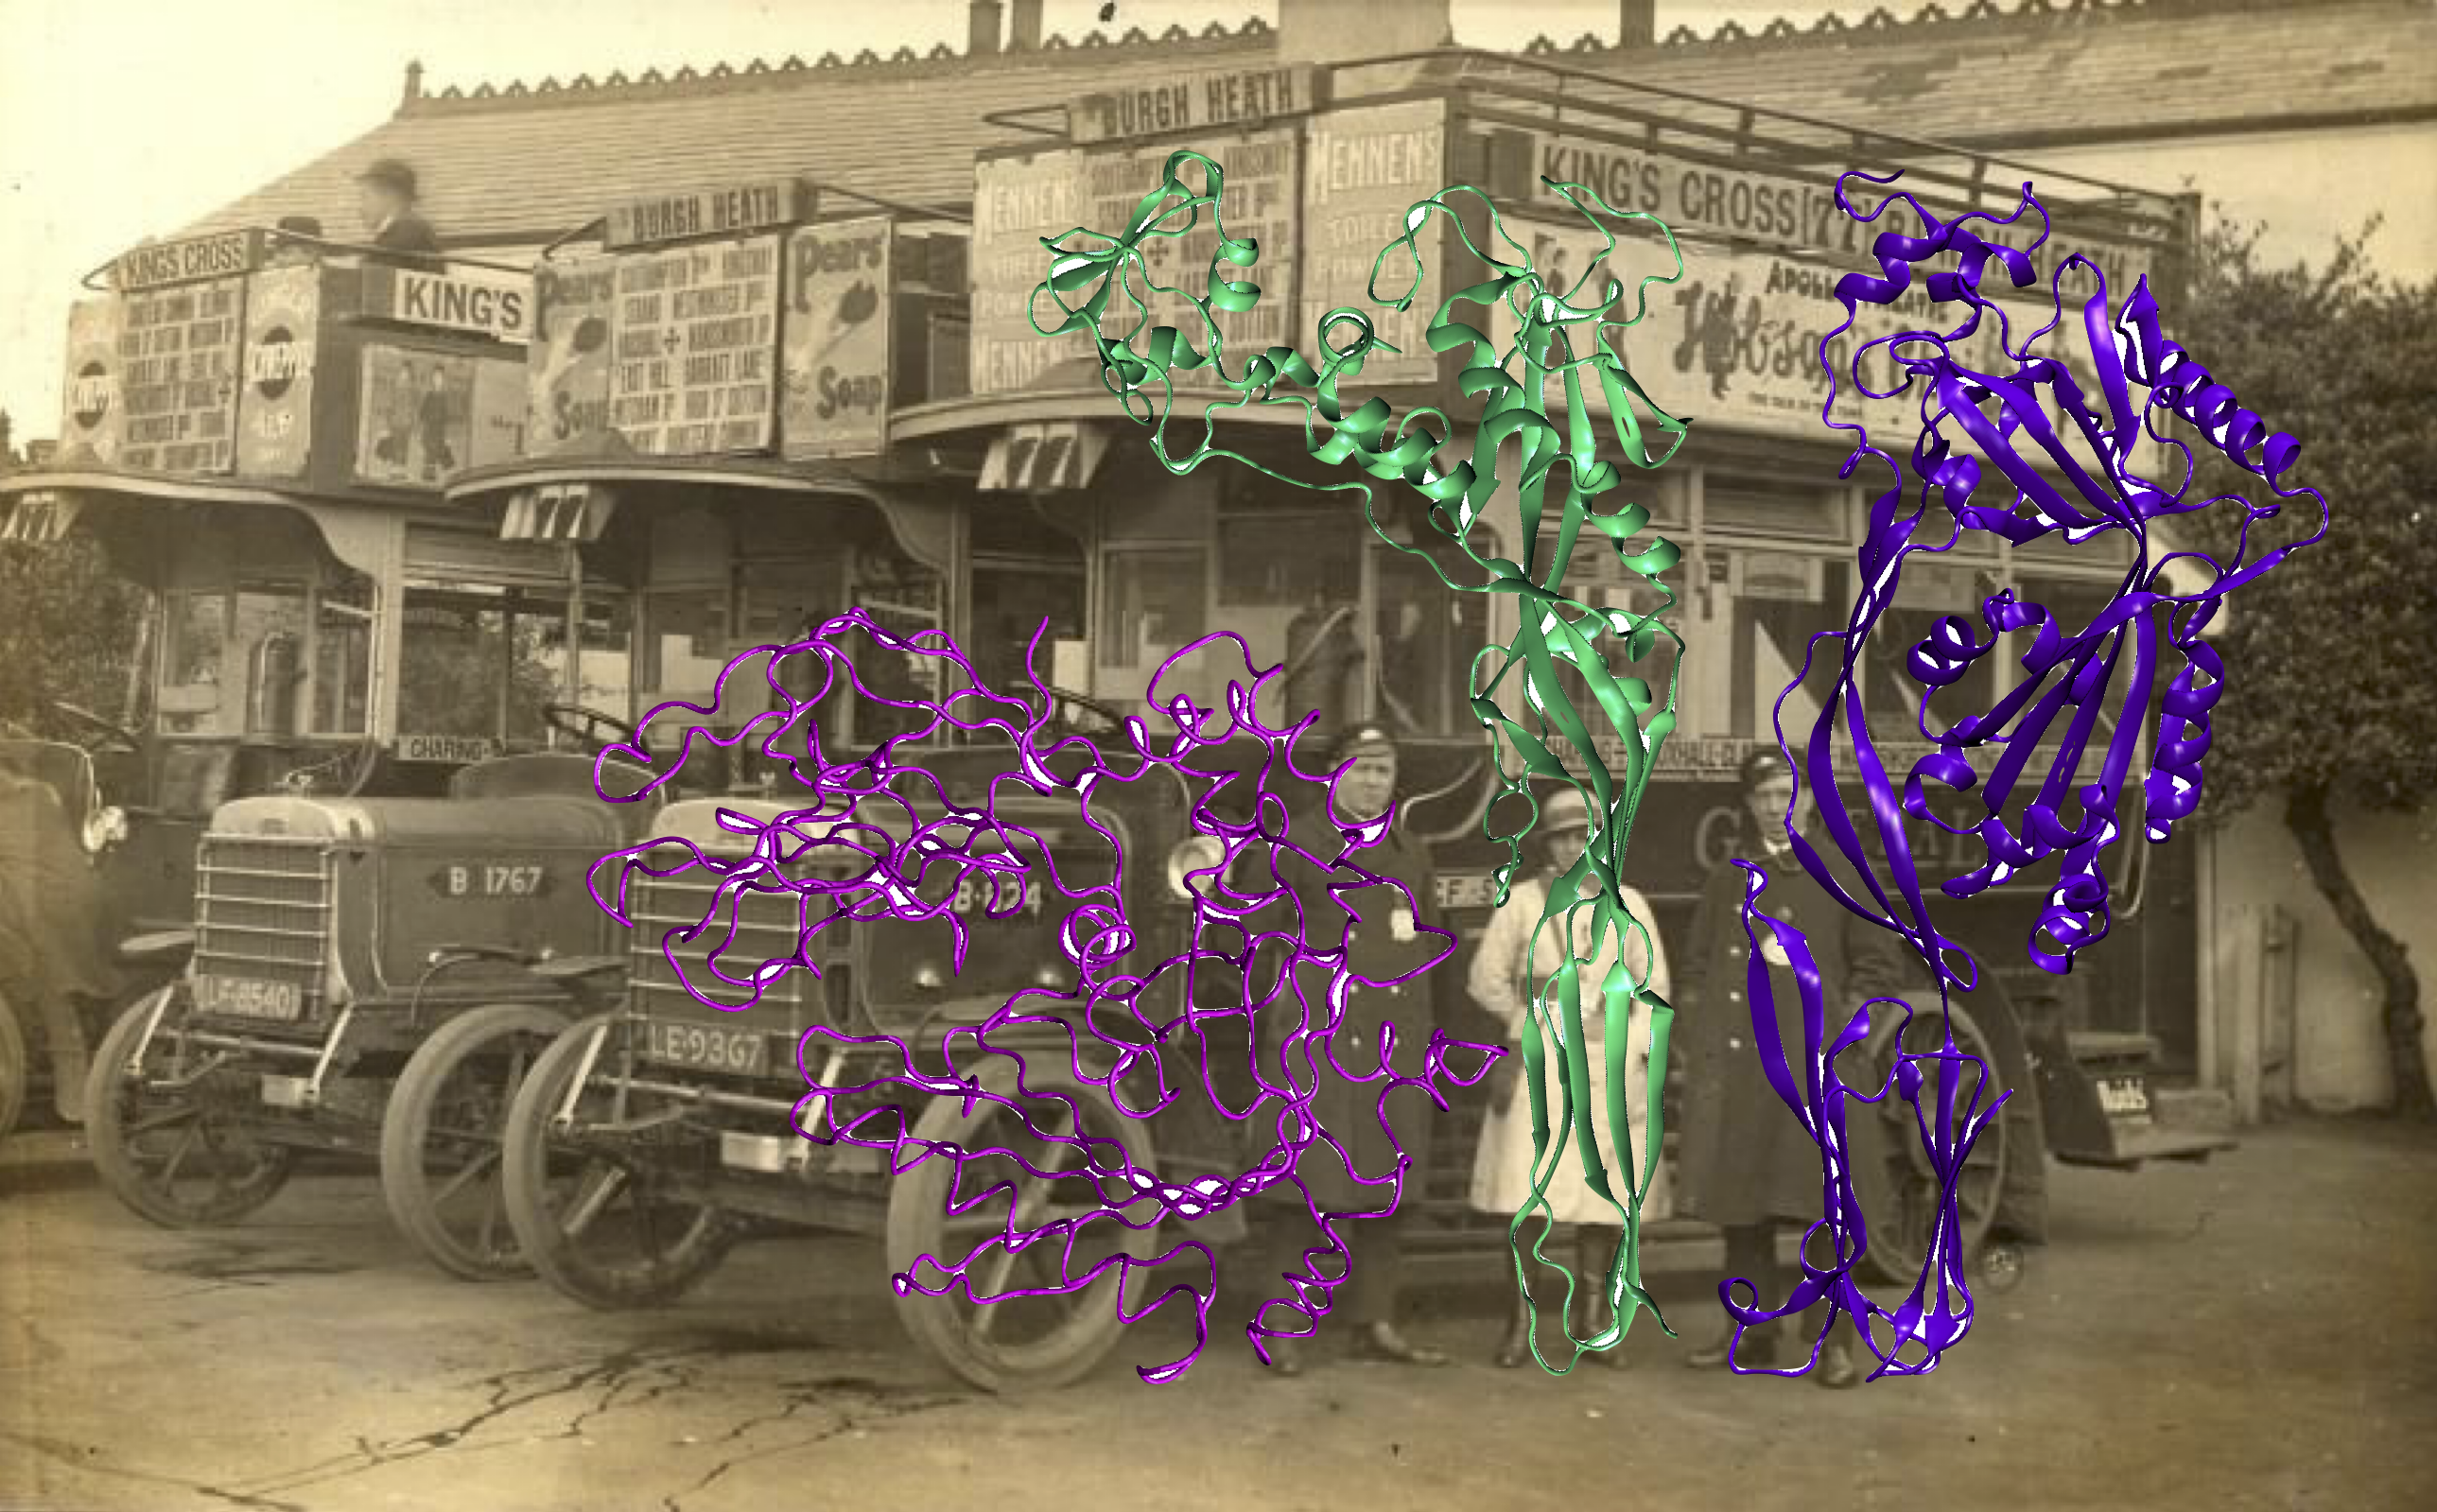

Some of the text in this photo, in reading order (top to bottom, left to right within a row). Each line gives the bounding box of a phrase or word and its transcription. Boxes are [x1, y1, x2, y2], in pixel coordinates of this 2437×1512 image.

[1207, 69, 1292, 123] HEATH
[633, 185, 778, 241] BURGH HEATH
[1542, 144, 1661, 212] KING'S
[1680, 170, 1796, 237] CROSS
[184, 236, 242, 273] CROSS
[1765, 260, 1838, 302] APOLL
[404, 276, 522, 329] KING'S
[816, 365, 881, 419] Soap
[1013, 424, 1078, 487] 77
[535, 484, 590, 539] 77
[450, 866, 544, 895] B 1767
